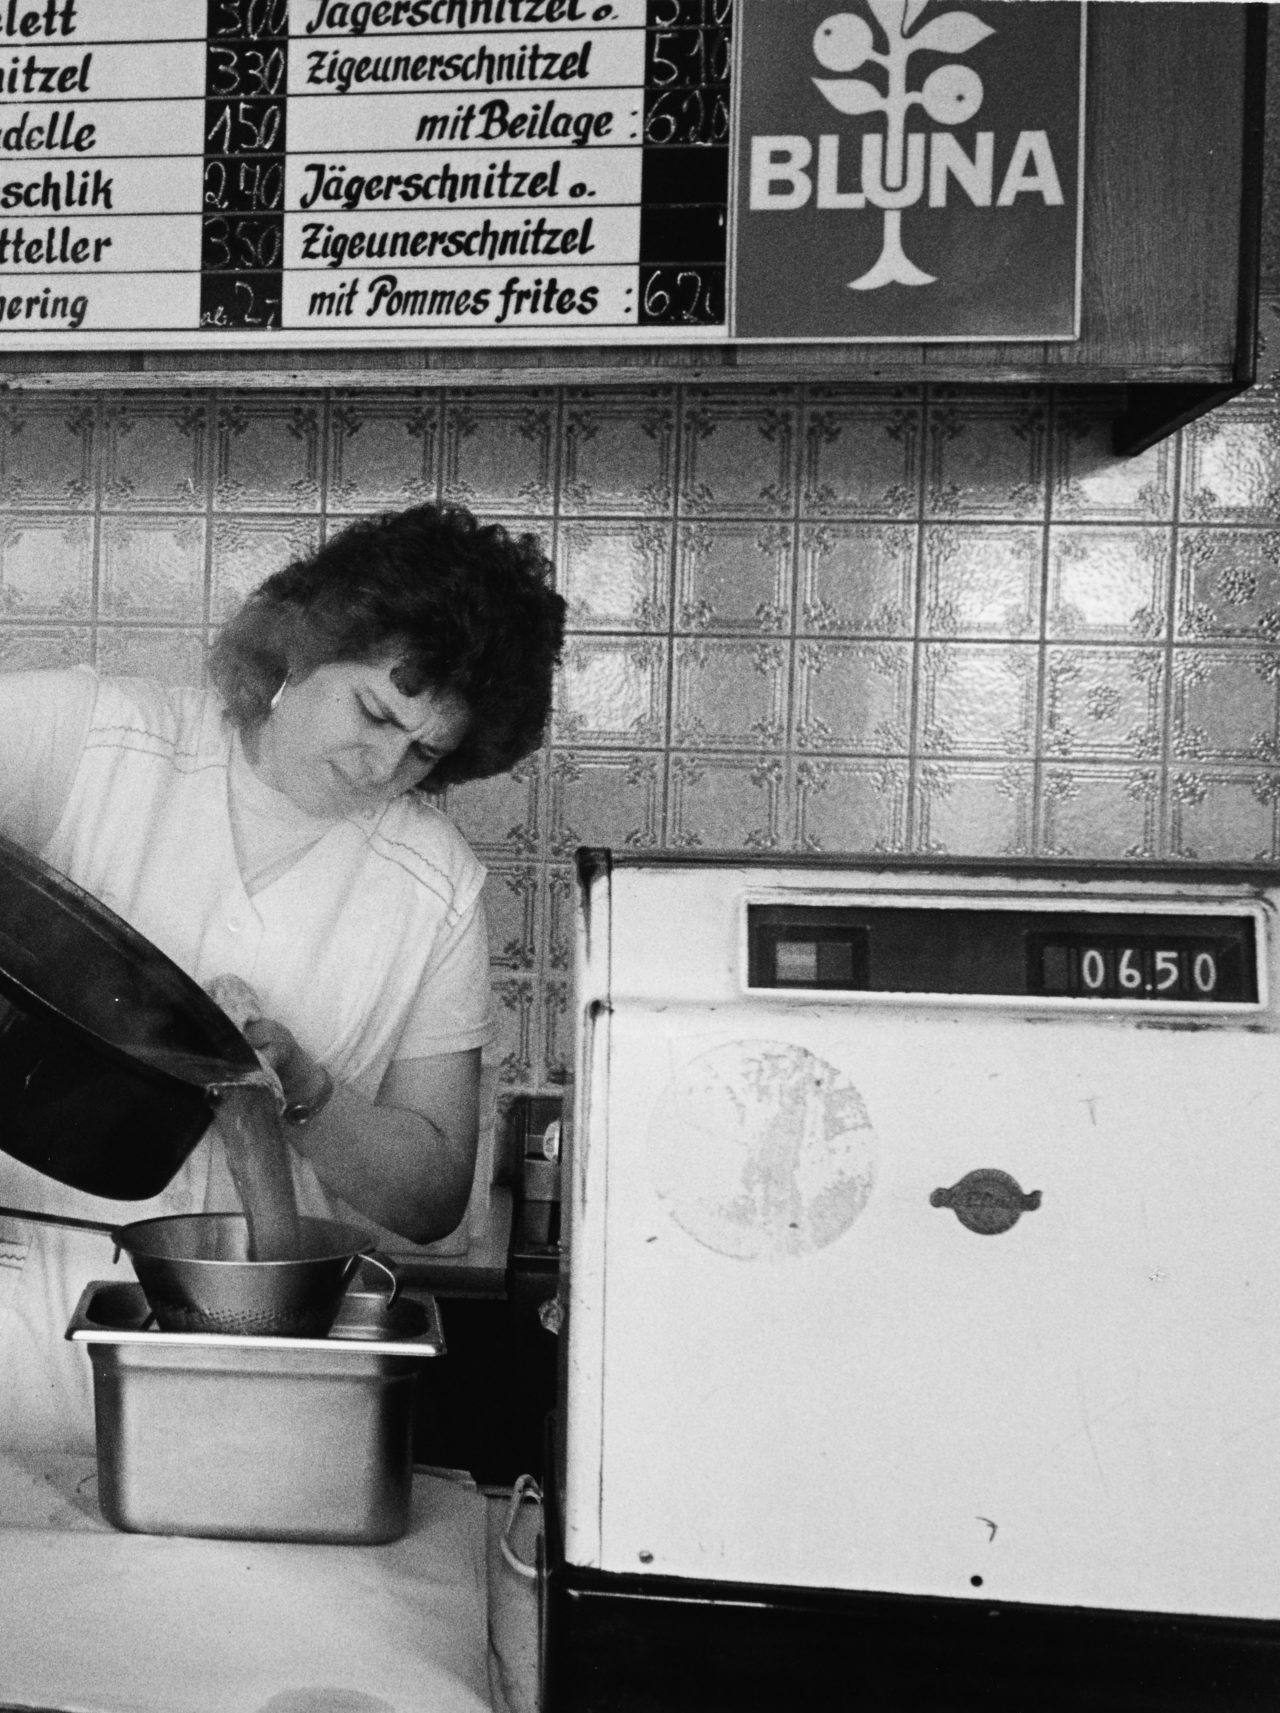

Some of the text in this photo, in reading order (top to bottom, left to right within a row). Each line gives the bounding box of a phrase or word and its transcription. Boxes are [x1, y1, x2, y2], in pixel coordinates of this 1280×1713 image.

[307, 42, 591, 94] Zigeunerschnitzel
[416, 103, 476, 142] mit
[478, 98, 613, 147] Beilage
[300, 161, 559, 211] Jägerschnitzel
[750, 130, 1065, 211] BLUNA
[301, 217, 594, 268] Zigeunerschnitzel
[308, 281, 358, 317] mit
[366, 275, 489, 319] Pommes
[497, 273, 599, 324] frites
